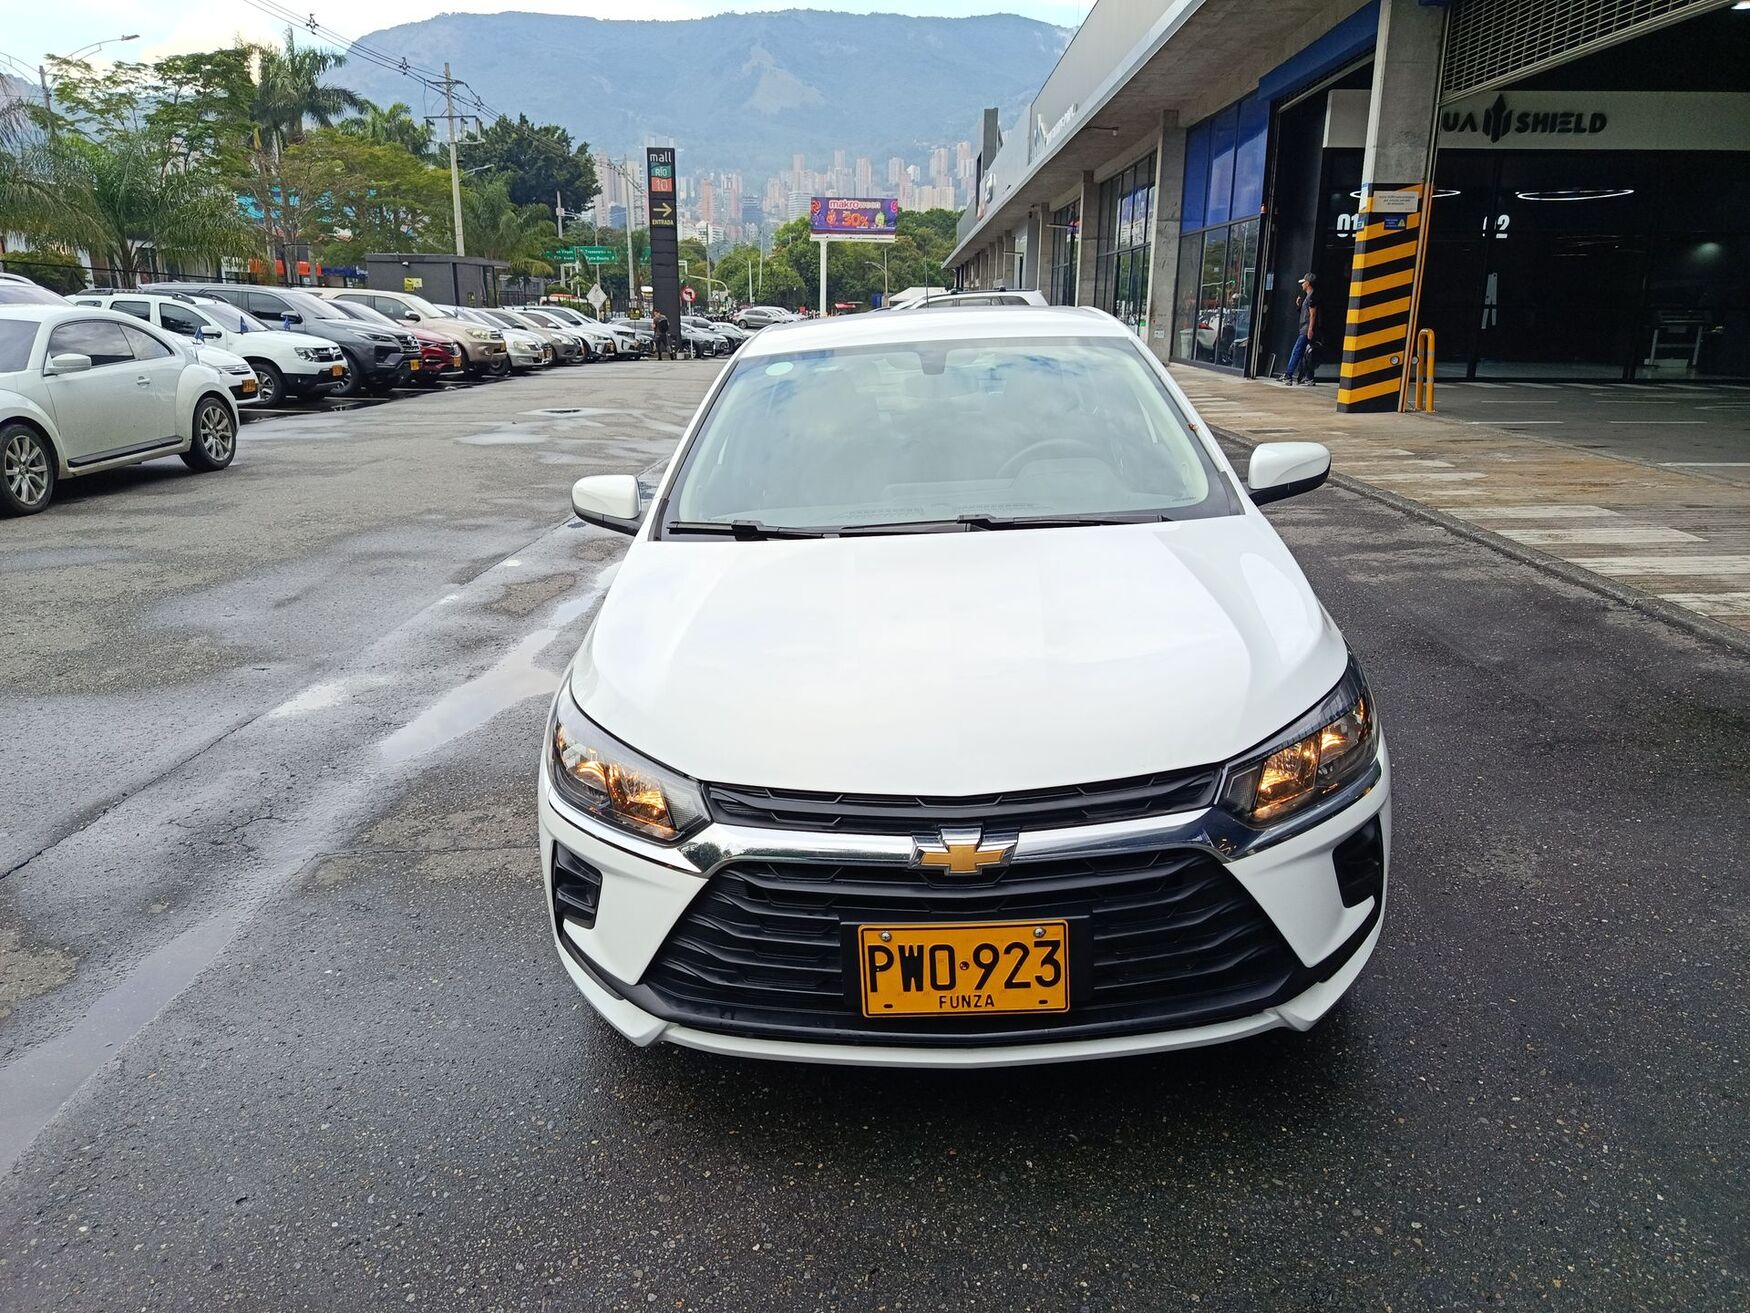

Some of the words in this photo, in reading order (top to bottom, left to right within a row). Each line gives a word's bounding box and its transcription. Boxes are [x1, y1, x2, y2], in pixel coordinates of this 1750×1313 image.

[1441, 111, 1478, 133] UA
[1514, 112, 1607, 134] SHIELD
[649, 151, 672, 163] mall
[656, 178, 669, 192] 10
[939, 994, 995, 1009] FUNZA
